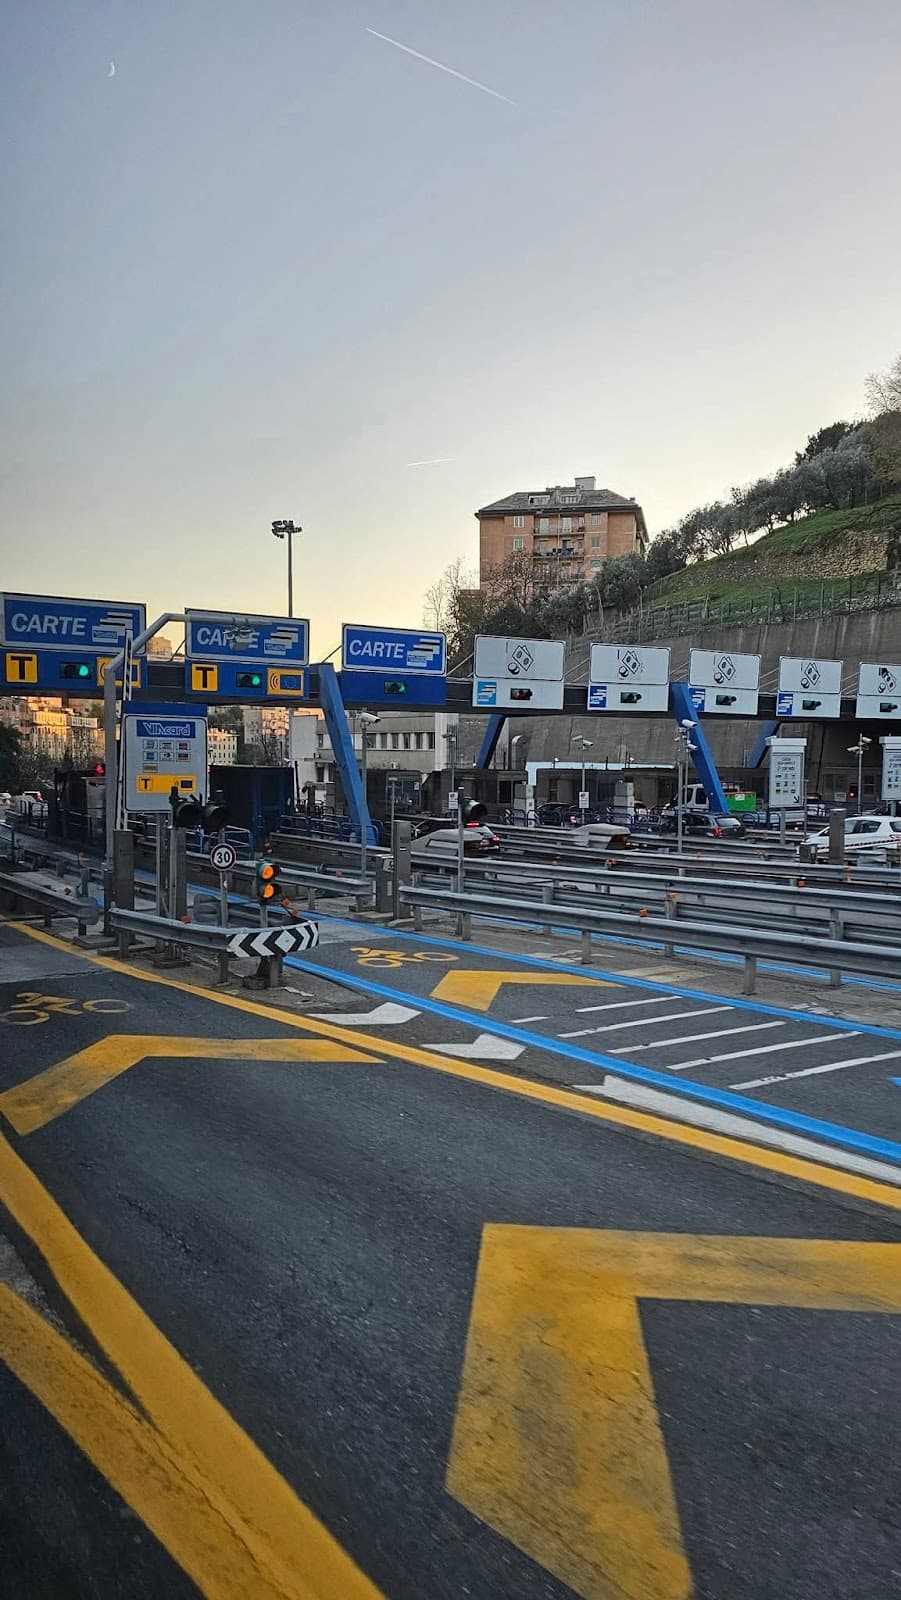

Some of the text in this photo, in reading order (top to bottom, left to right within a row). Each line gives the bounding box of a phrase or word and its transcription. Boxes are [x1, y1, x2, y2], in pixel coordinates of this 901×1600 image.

[11, 613, 87, 636] CARTE
[197, 627, 260, 649] CARE
[349, 639, 405, 658] CARTE
[10, 655, 33, 680] T
[195, 666, 214, 688] T
[140, 778, 151, 789] T
[216, 851, 231, 864] 30
